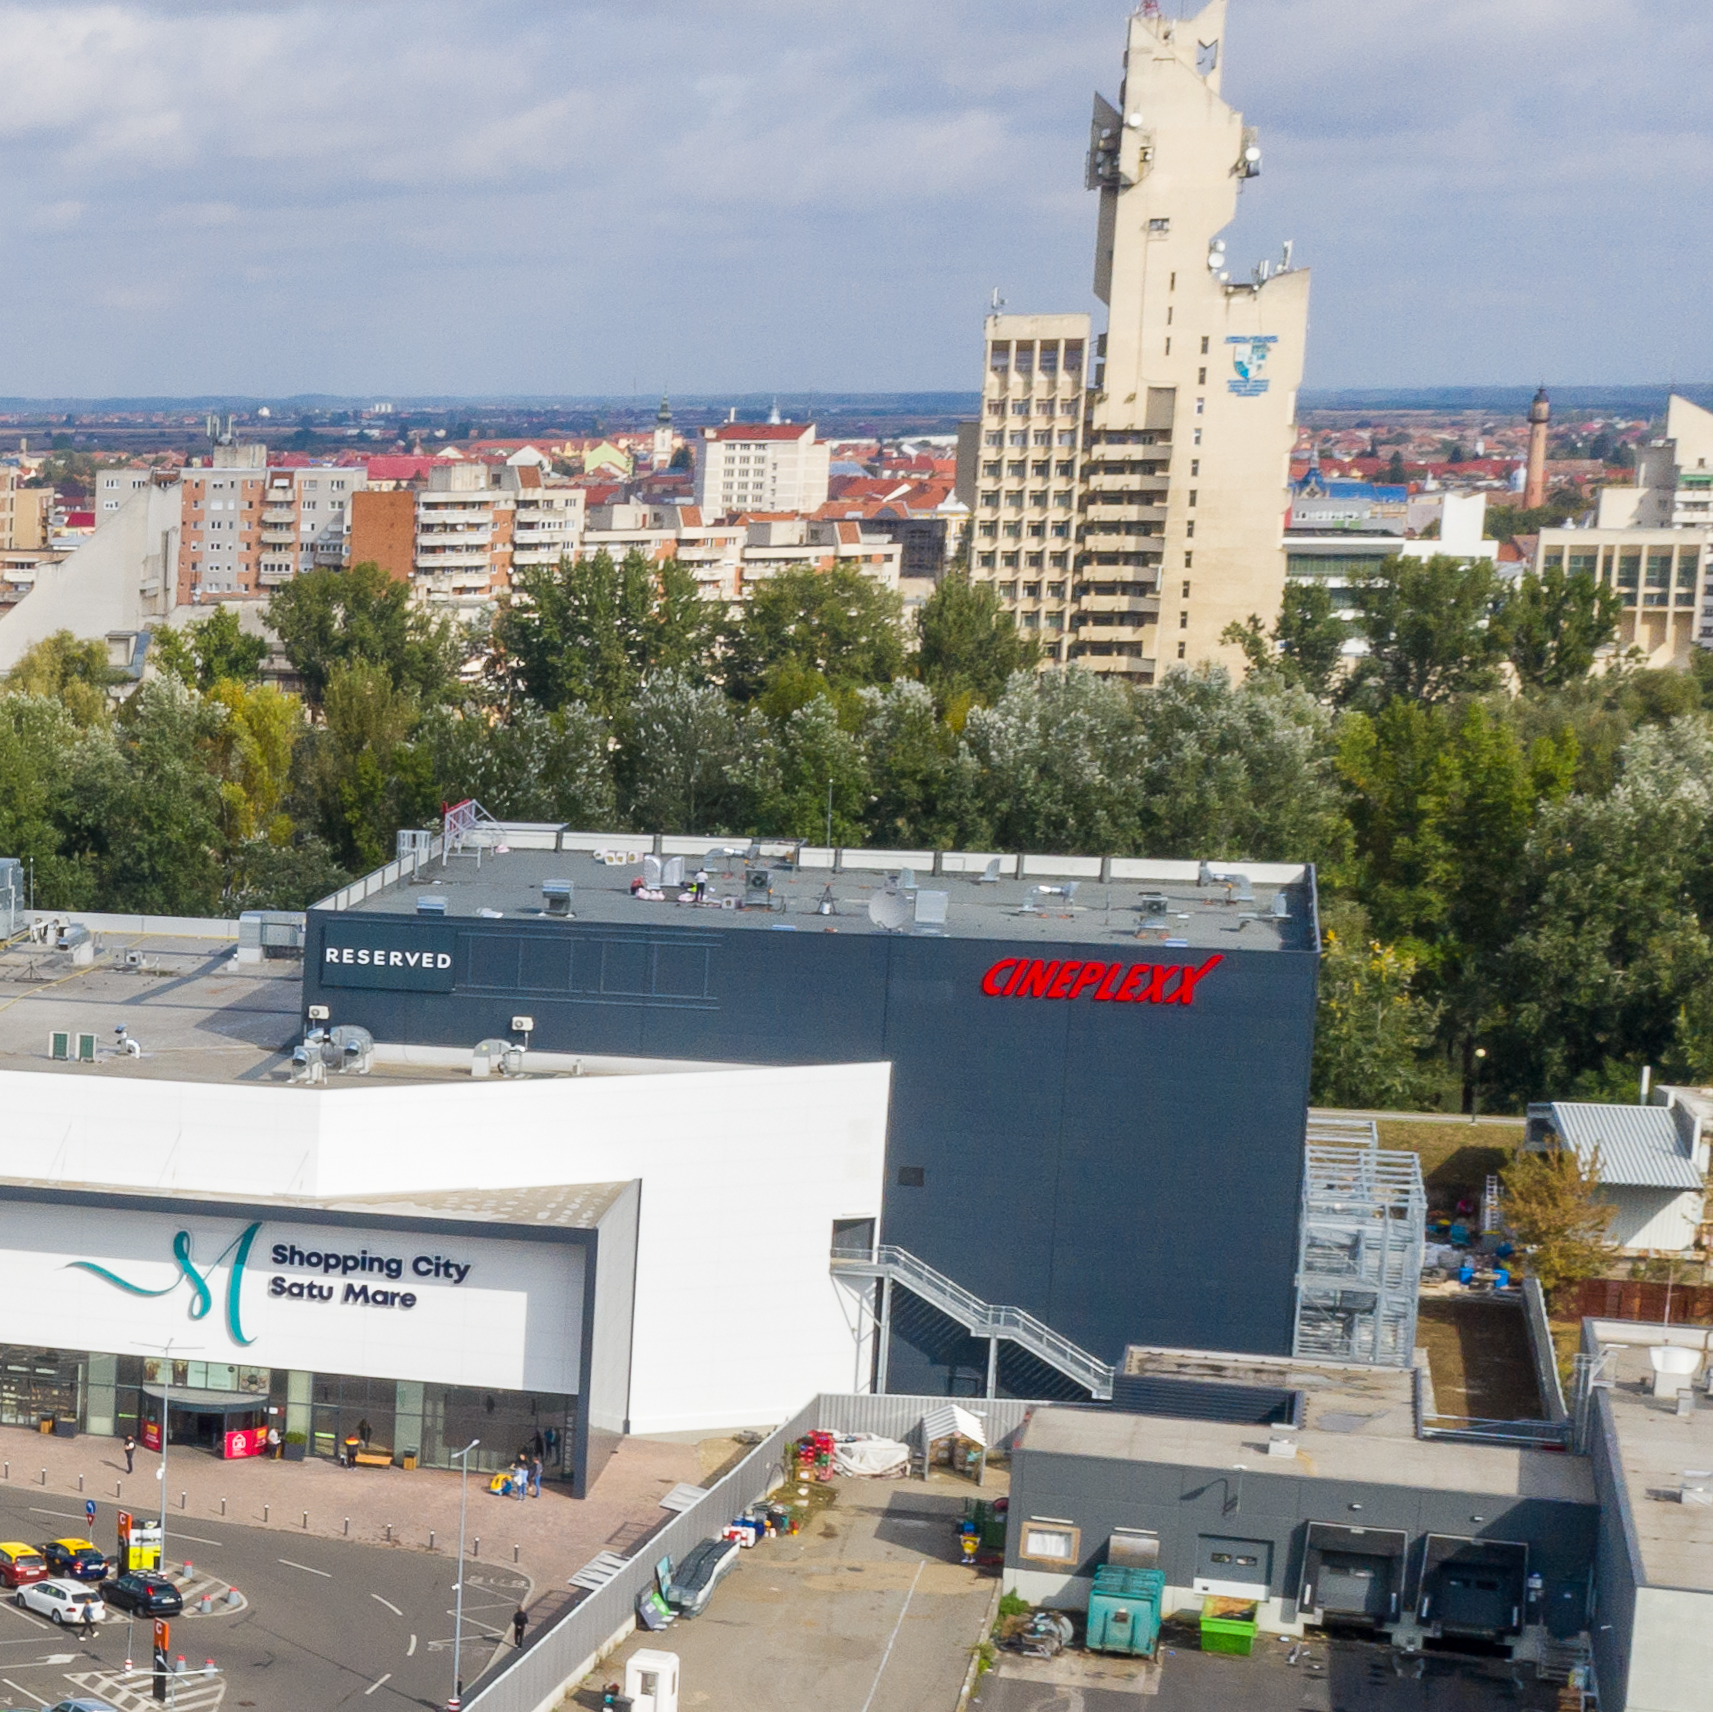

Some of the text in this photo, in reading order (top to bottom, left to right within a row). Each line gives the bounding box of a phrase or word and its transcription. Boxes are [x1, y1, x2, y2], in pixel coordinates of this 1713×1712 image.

[325, 947, 451, 969] RESERVED
[981, 953, 1224, 1005] CINEPLEXX
[272, 1243, 471, 1285] Shopping City
[270, 1276, 418, 1310] Satu Mare
